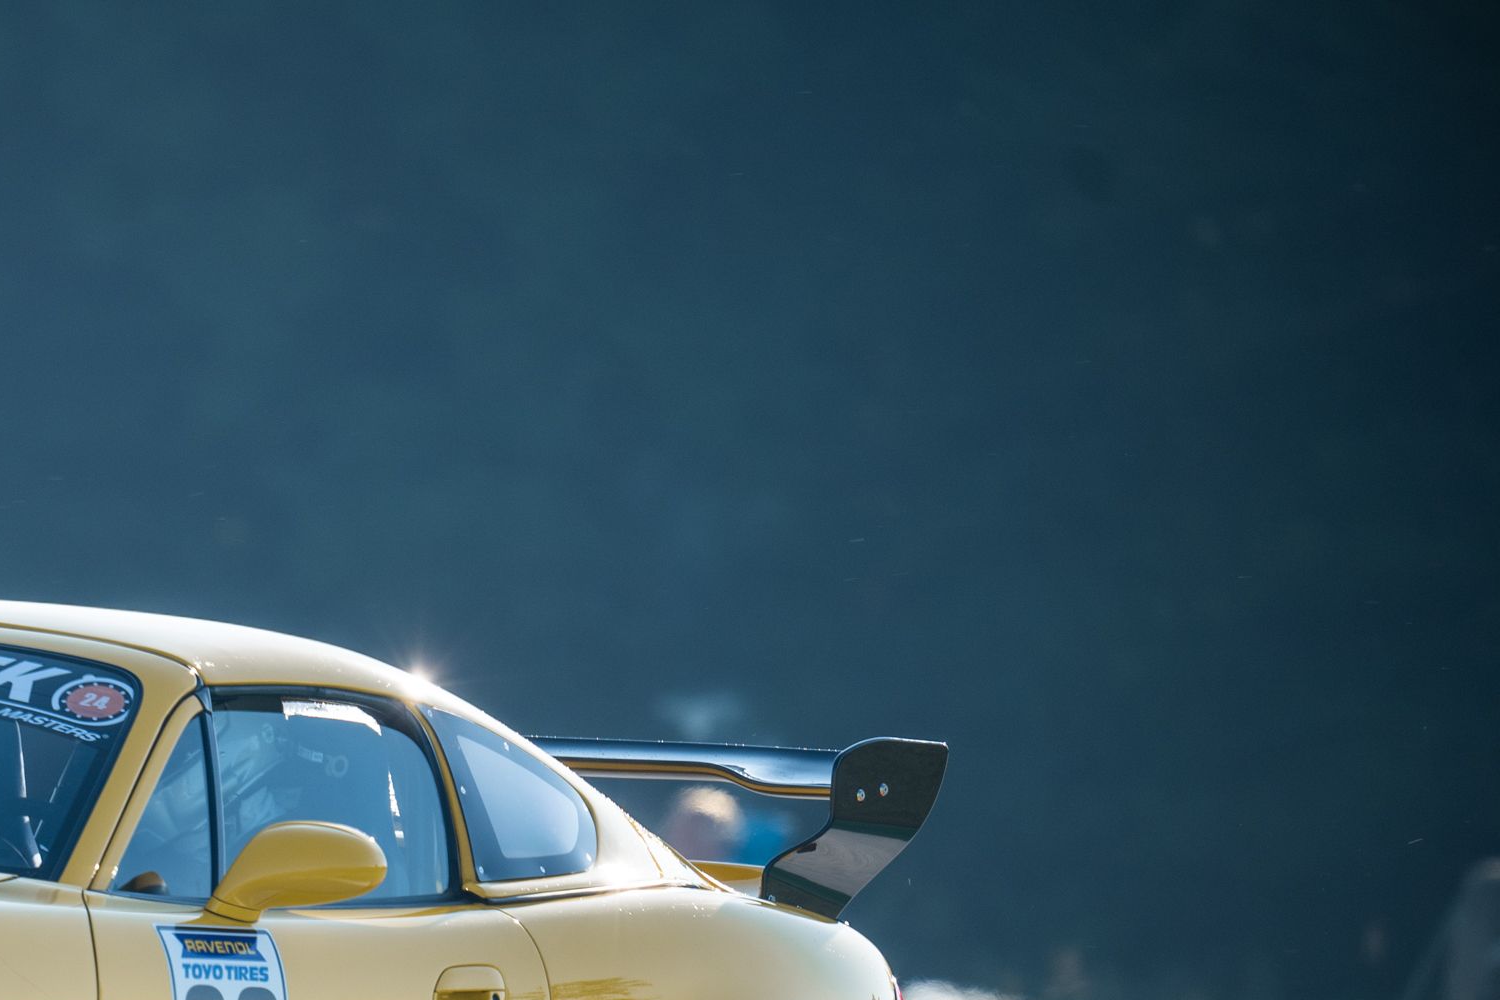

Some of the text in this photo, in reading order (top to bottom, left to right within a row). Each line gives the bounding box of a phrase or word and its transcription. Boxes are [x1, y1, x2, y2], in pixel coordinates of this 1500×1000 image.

[79, 691, 111, 710] 24
[183, 938, 256, 955] RAVENOL
[182, 963, 269, 982] TOYO TIRES
